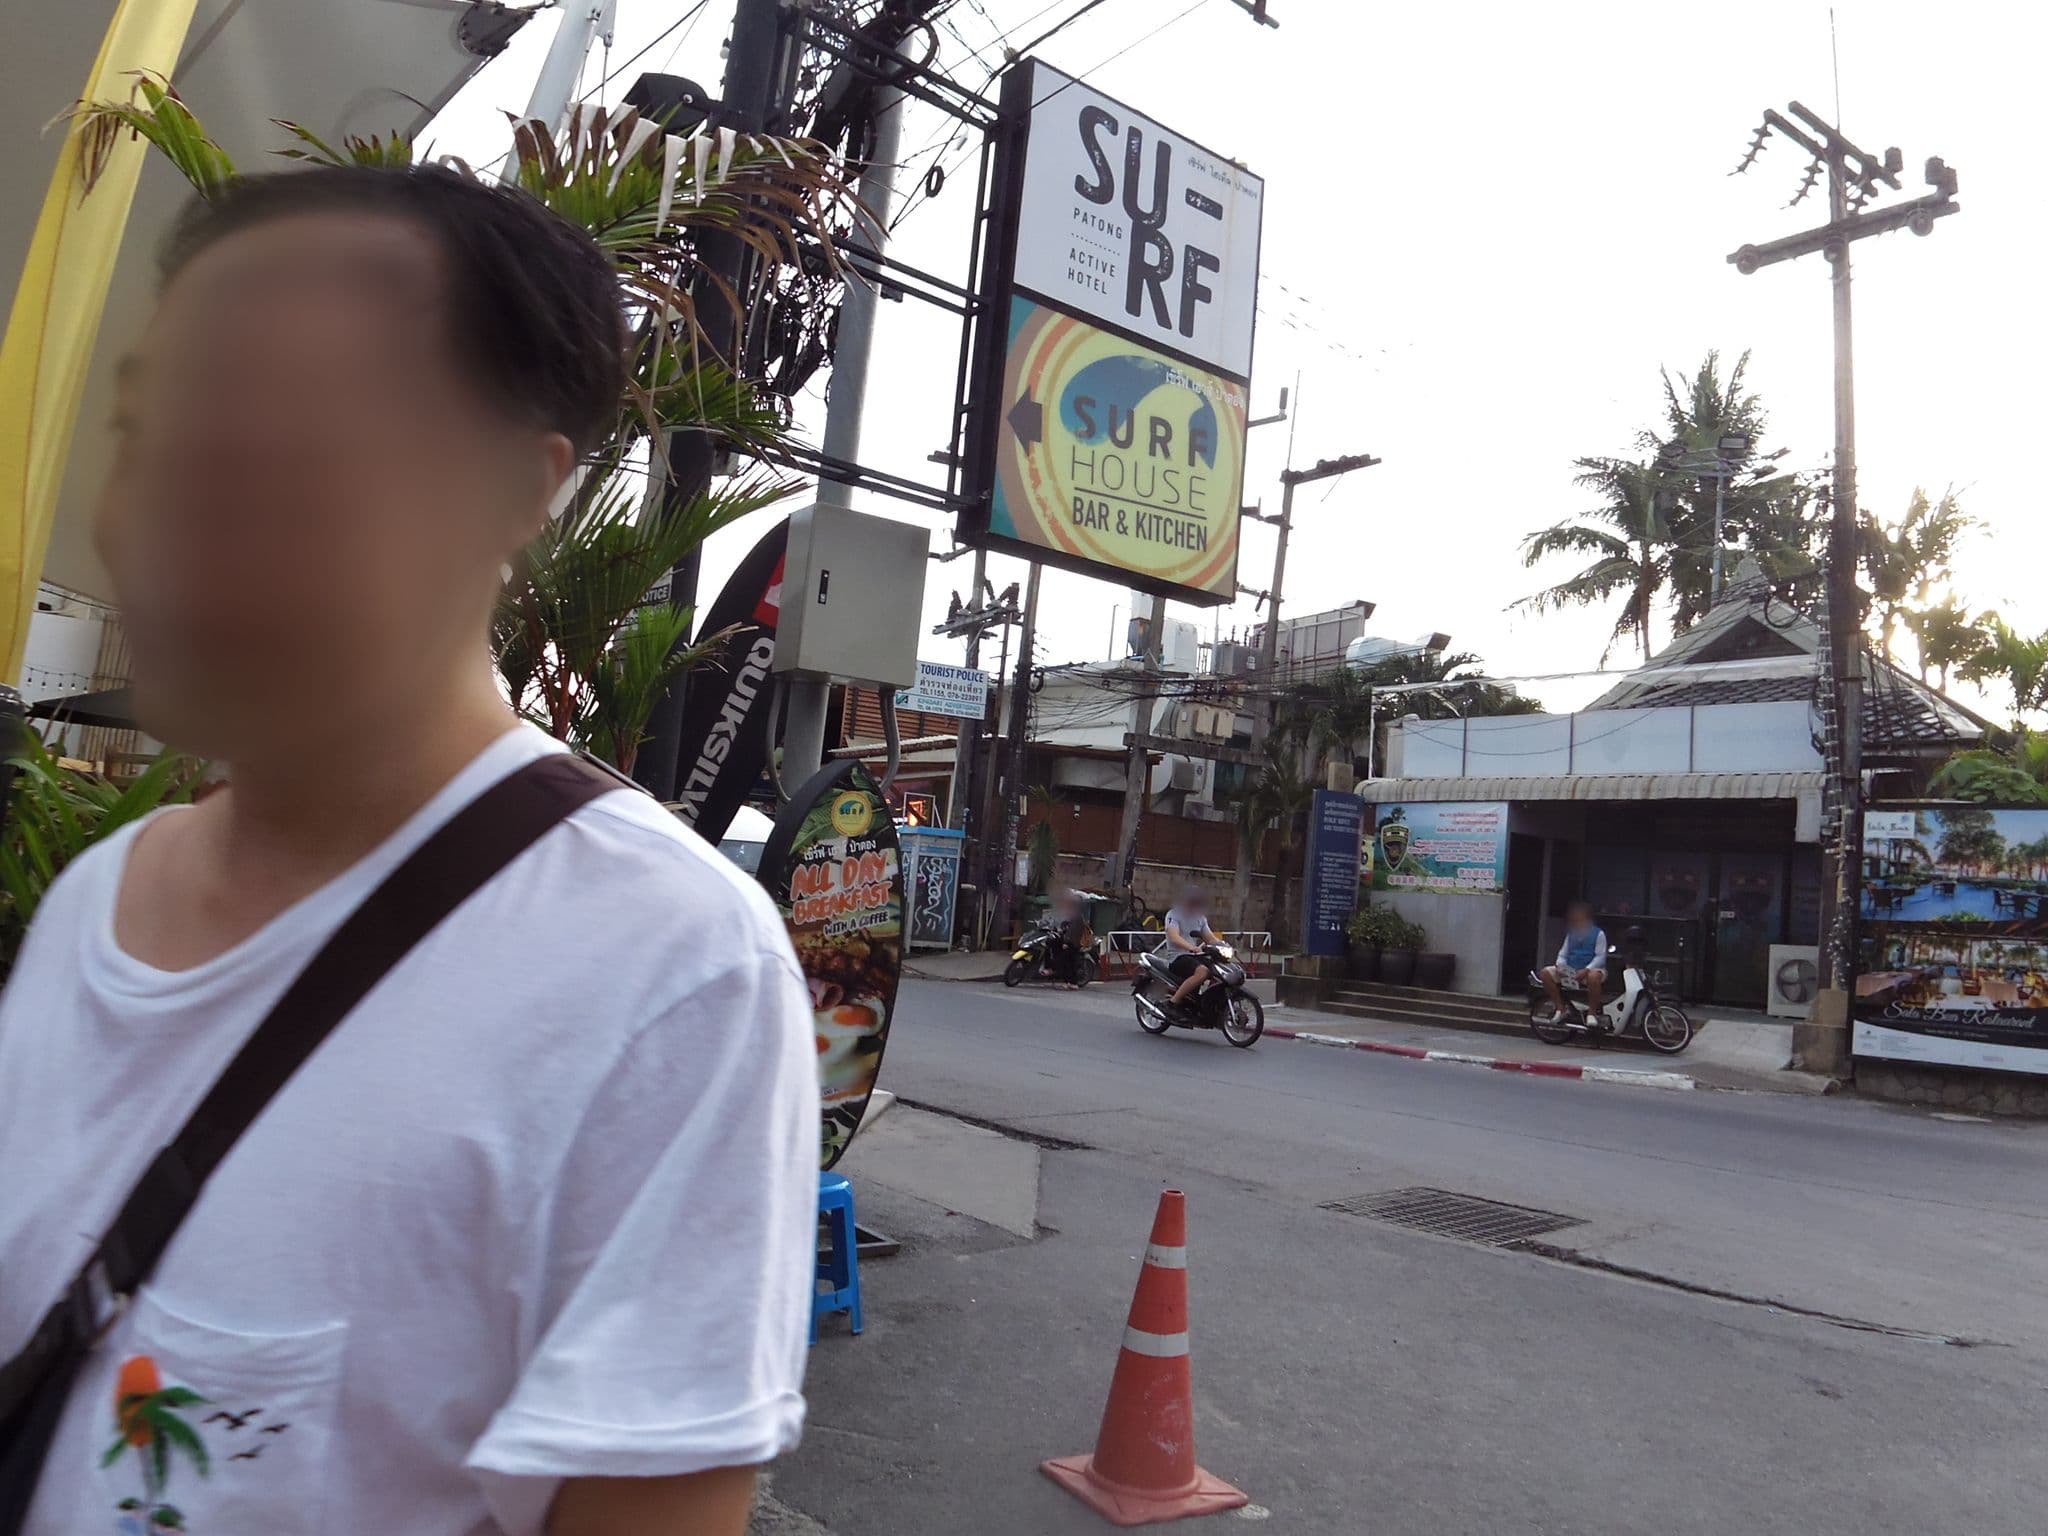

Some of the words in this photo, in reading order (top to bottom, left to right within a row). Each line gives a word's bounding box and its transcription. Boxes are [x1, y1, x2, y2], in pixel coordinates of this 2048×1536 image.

[1073, 207, 1123, 240] PATONG
[1067, 268, 1107, 295] HOTEL
[1069, 247, 1116, 278] ACTIVE
[1073, 395, 1208, 467] SURF
[1071, 444, 1206, 513] HOUSE
[1072, 496, 1109, 533] BAR
[1115, 509, 1129, 536] &
[1136, 511, 1208, 553] KITCHEN
[921, 664, 955, 678] TOURIST
[956, 670, 983, 682] POLICE
[673, 637, 776, 829] QUIKSILV
[791, 862, 834, 900] ALL
[842, 851, 889, 888] DAY
[793, 882, 892, 925] BREAKFAST
[824, 921, 847, 936] WITH
[850, 918, 857, 928] A
[859, 911, 889, 926] COFFEE
